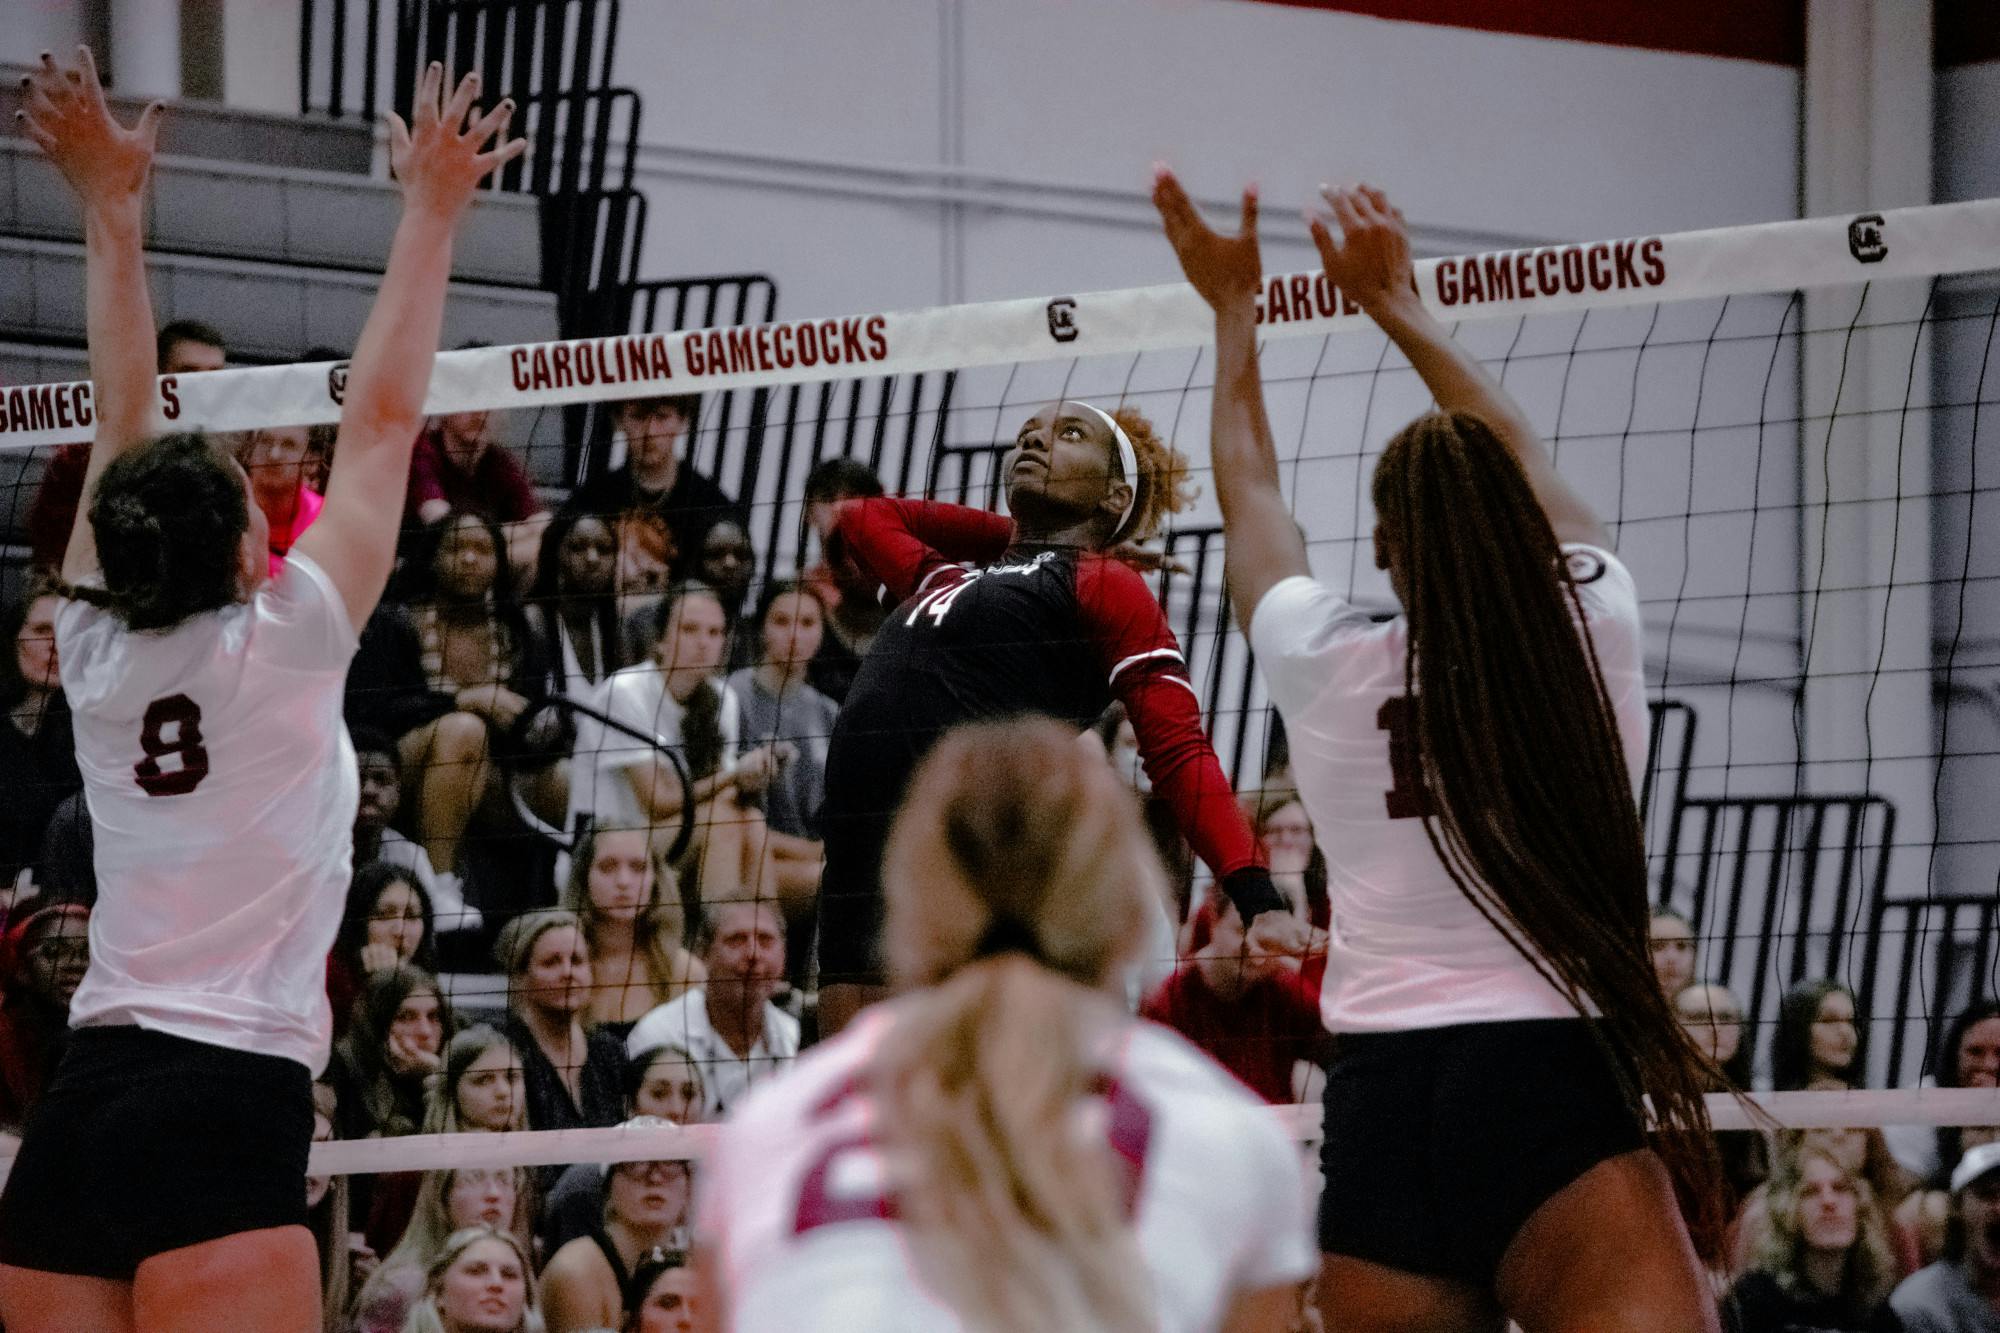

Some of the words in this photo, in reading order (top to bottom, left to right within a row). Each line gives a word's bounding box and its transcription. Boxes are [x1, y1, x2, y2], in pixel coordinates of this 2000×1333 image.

[1435, 237, 1665, 306] GAMECOCKS
[511, 335, 671, 391] CAROLINA
[684, 316, 887, 376] GAMECOCKS
[134, 693, 209, 797] 8
